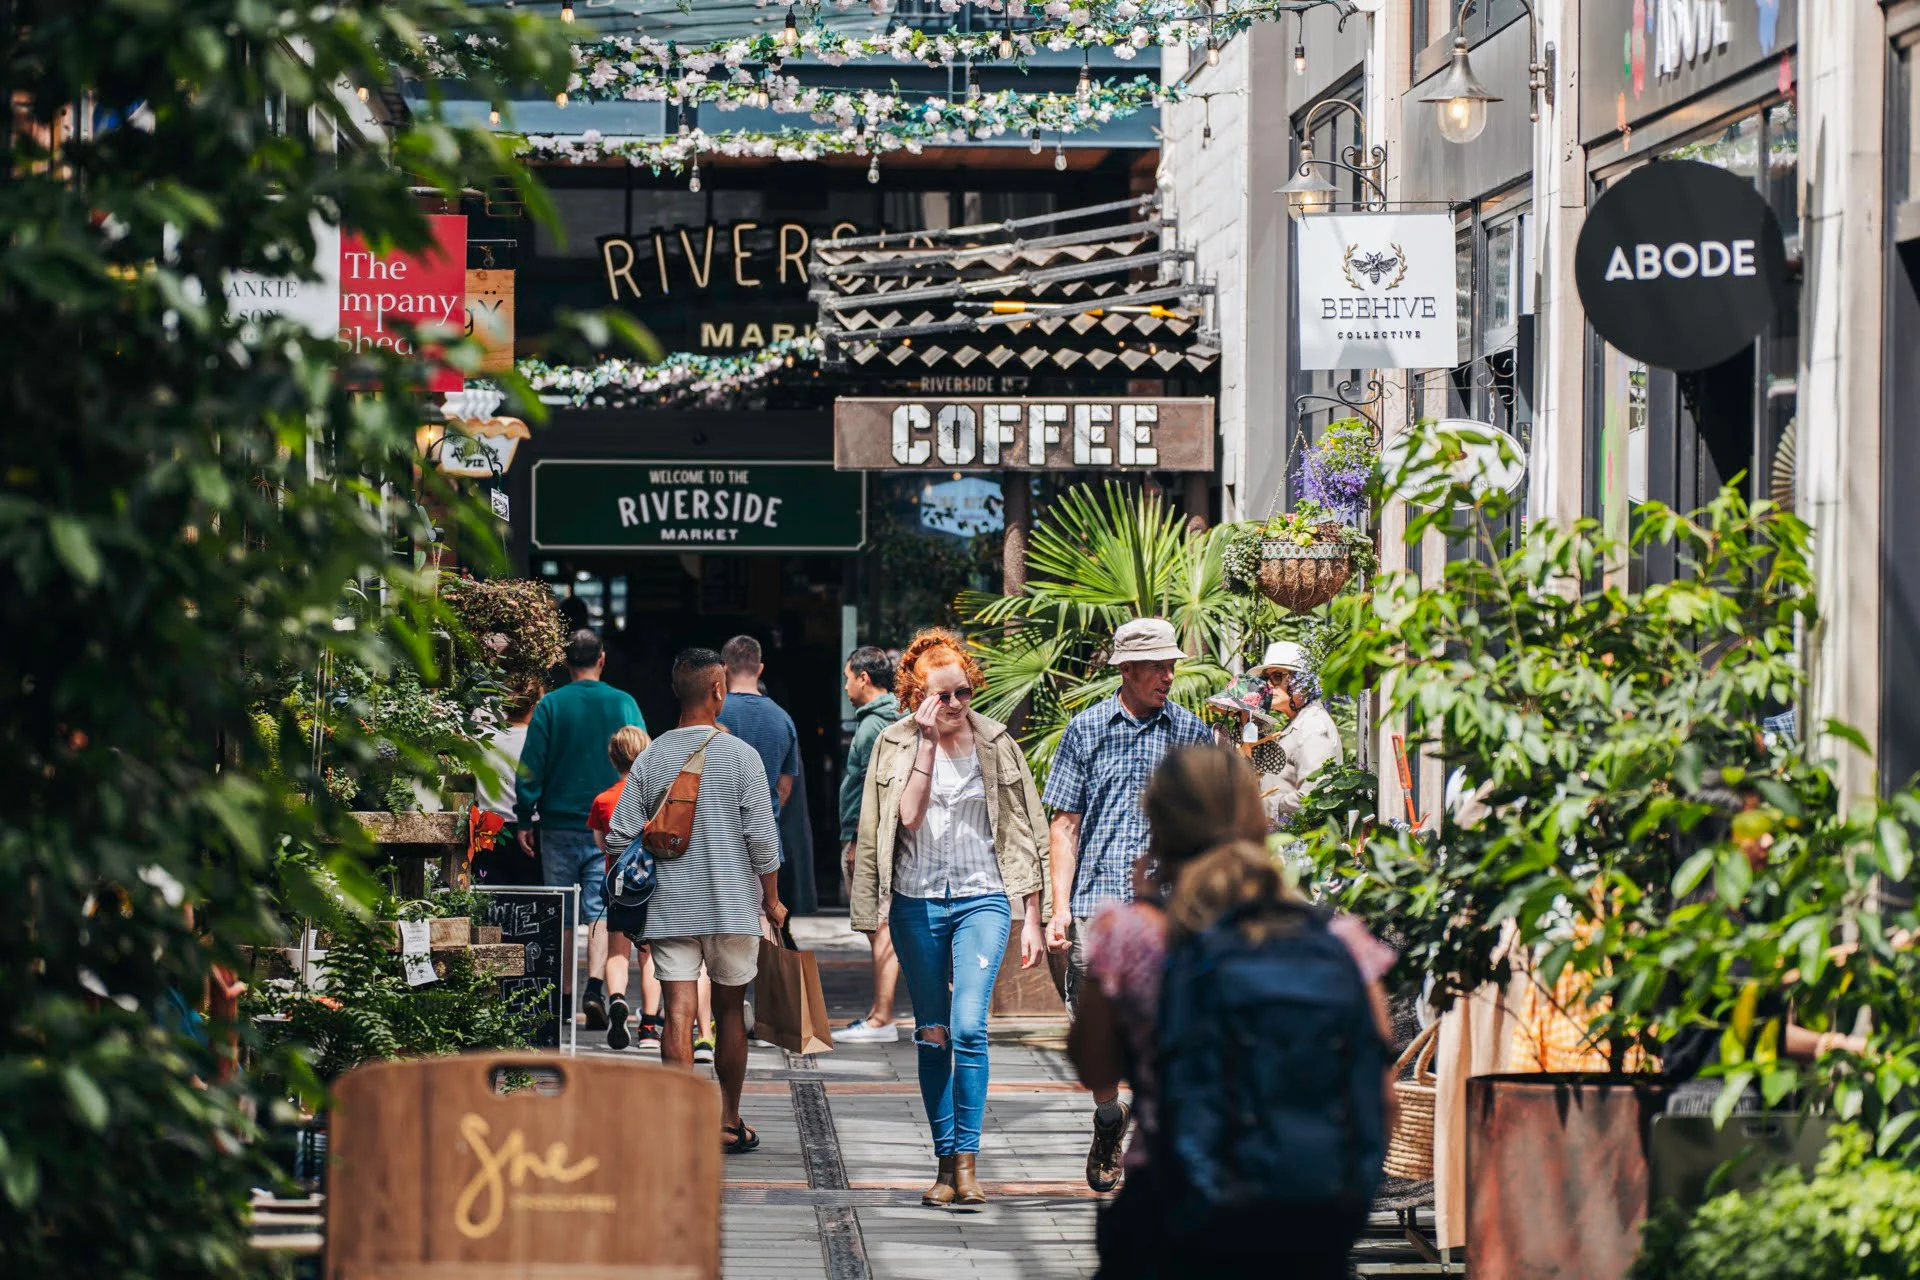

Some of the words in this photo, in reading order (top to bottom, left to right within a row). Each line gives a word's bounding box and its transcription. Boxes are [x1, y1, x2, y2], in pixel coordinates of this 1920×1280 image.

[344, 251, 408, 281] The
[1604, 238, 1757, 283] ABODE
[1321, 296, 1437, 320] BEEHIVE
[1337, 330, 1422, 340] COLLECTIVE
[920, 375, 994, 392] RIVERSIDE
[891, 403, 1159, 466] COFFEE
[649, 469, 704, 485] WELCOME
[709, 470, 725, 485] TO
[728, 470, 749, 485] THE
[617, 488, 783, 528] RIVERSIDE
[660, 528, 740, 541] MARKET
